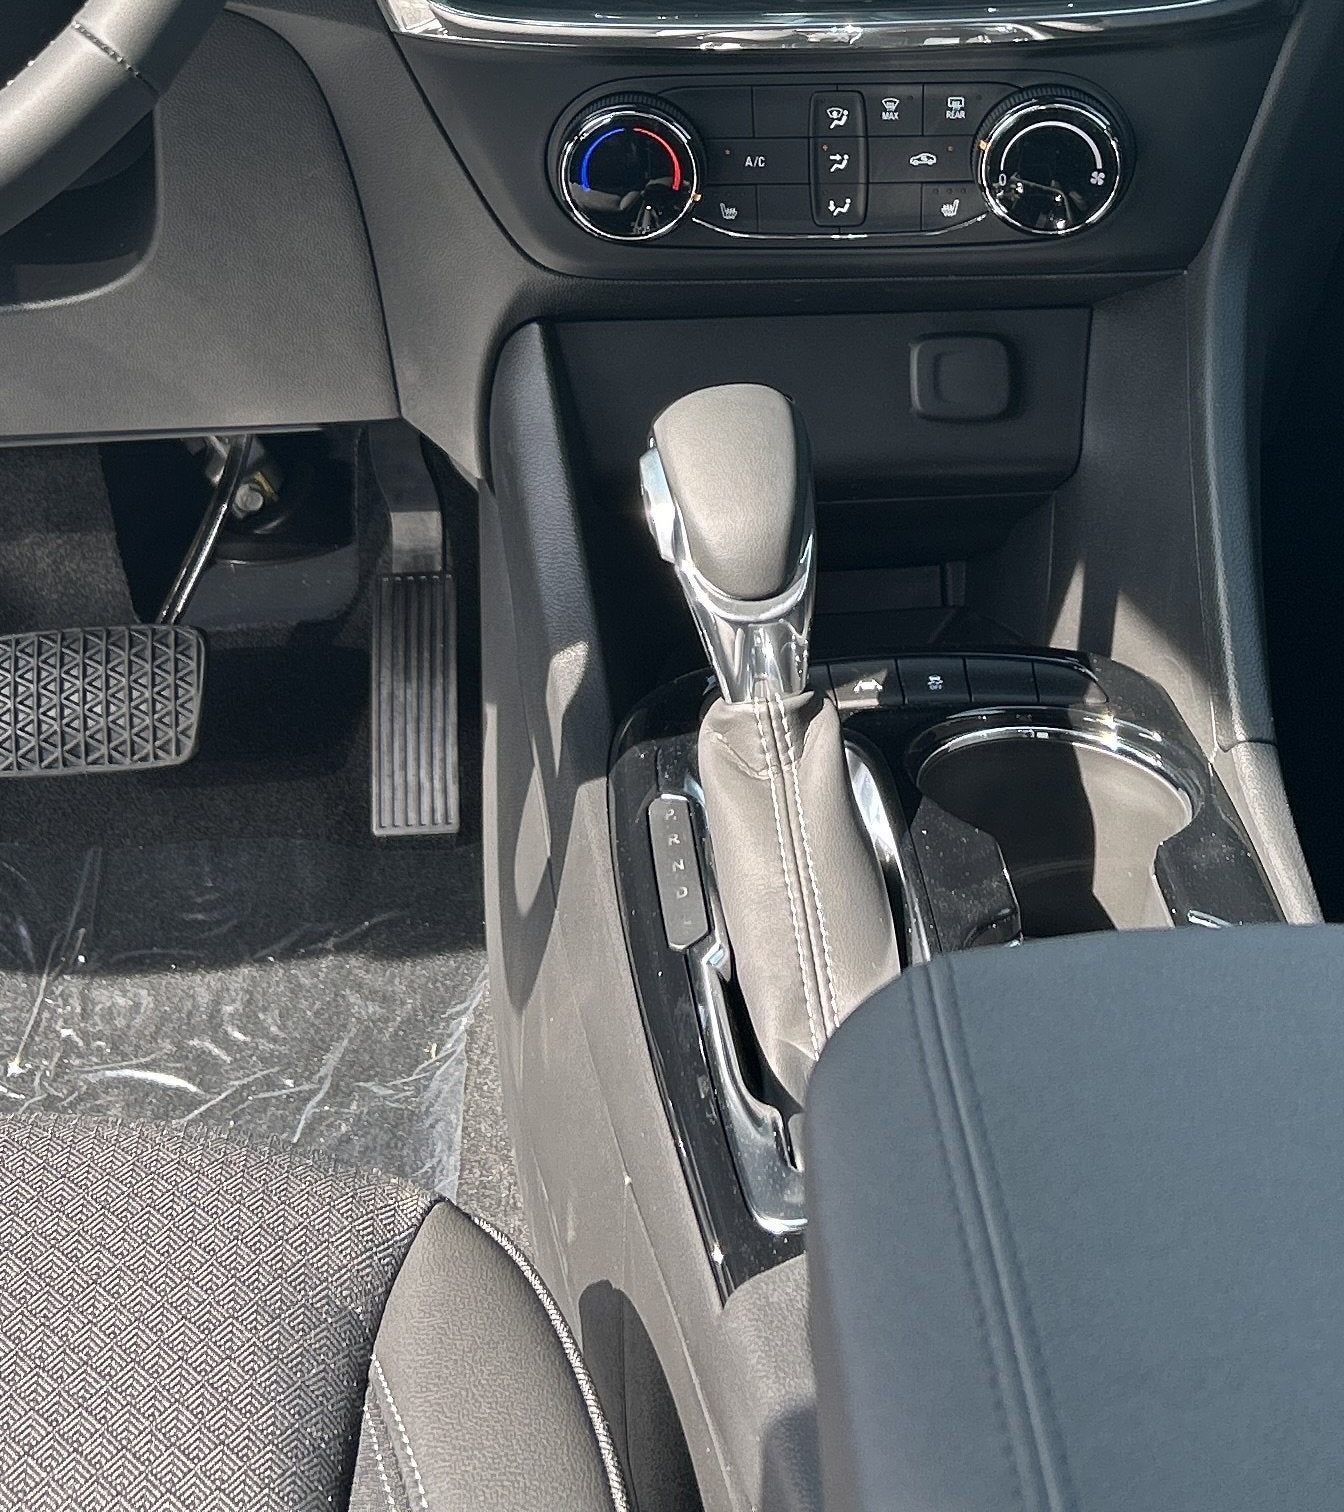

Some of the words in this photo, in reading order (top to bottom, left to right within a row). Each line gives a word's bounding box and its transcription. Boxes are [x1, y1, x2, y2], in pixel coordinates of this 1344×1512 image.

[881, 111, 899, 121] MAX
[946, 110, 966, 119] REAR
[744, 155, 766, 169] A/C
[665, 808, 675, 820] P
[668, 833, 680, 845] R
[672, 858, 685, 872] N
[676, 886, 688, 899] D
